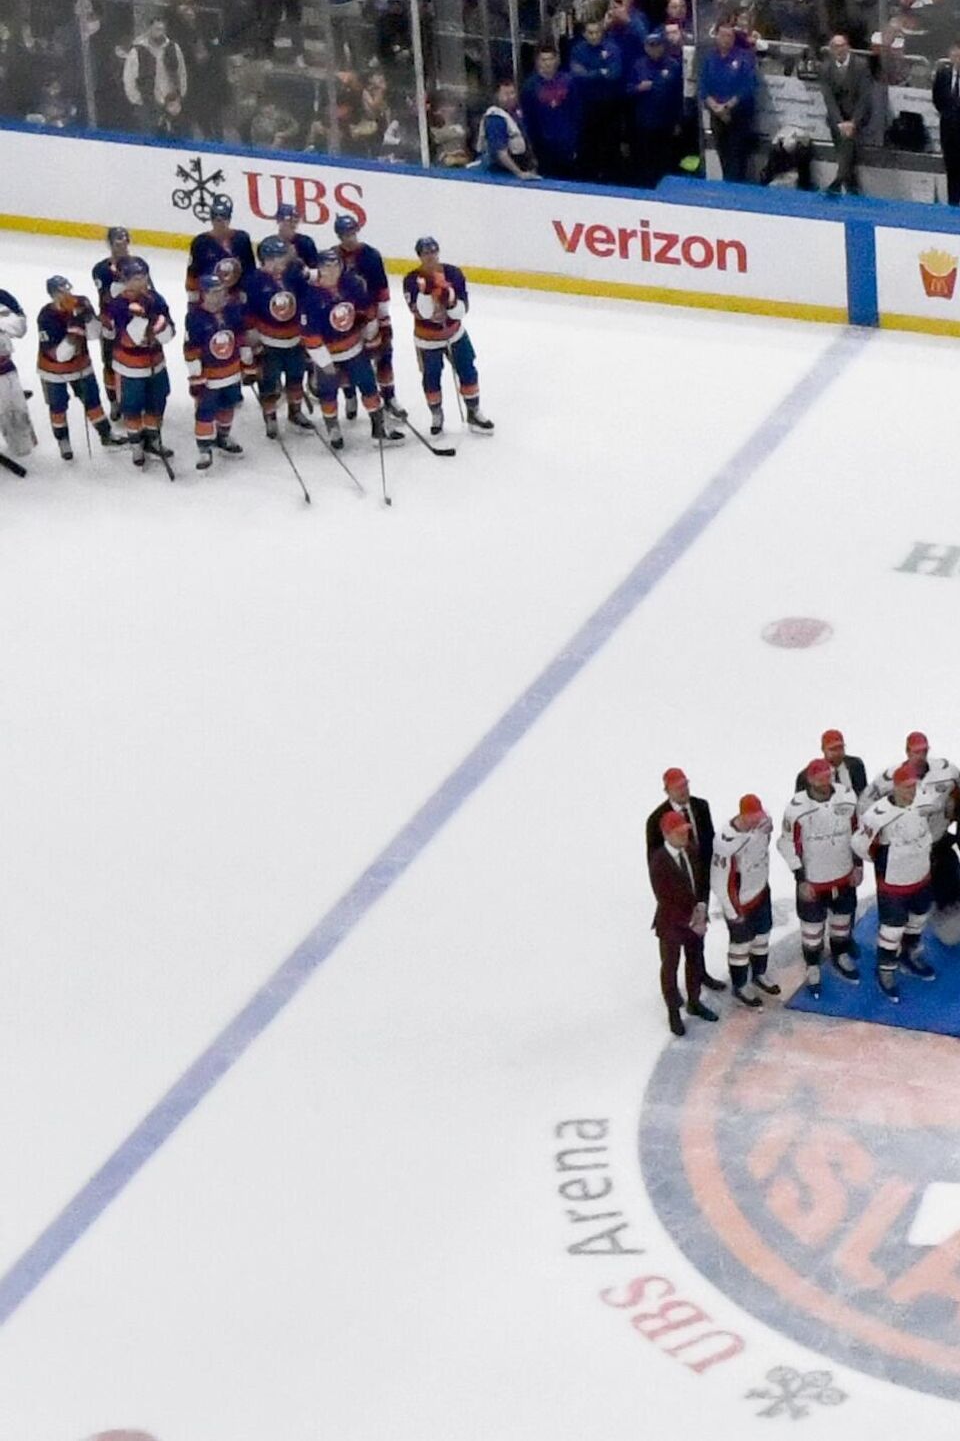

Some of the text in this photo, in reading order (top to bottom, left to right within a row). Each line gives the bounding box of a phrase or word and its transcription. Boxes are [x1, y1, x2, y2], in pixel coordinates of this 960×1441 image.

[243, 171, 368, 228] UBS
[551, 219, 748, 273] verizon
[555, 1117, 646, 1255] Arena
[600, 1275, 745, 1374] UBS
